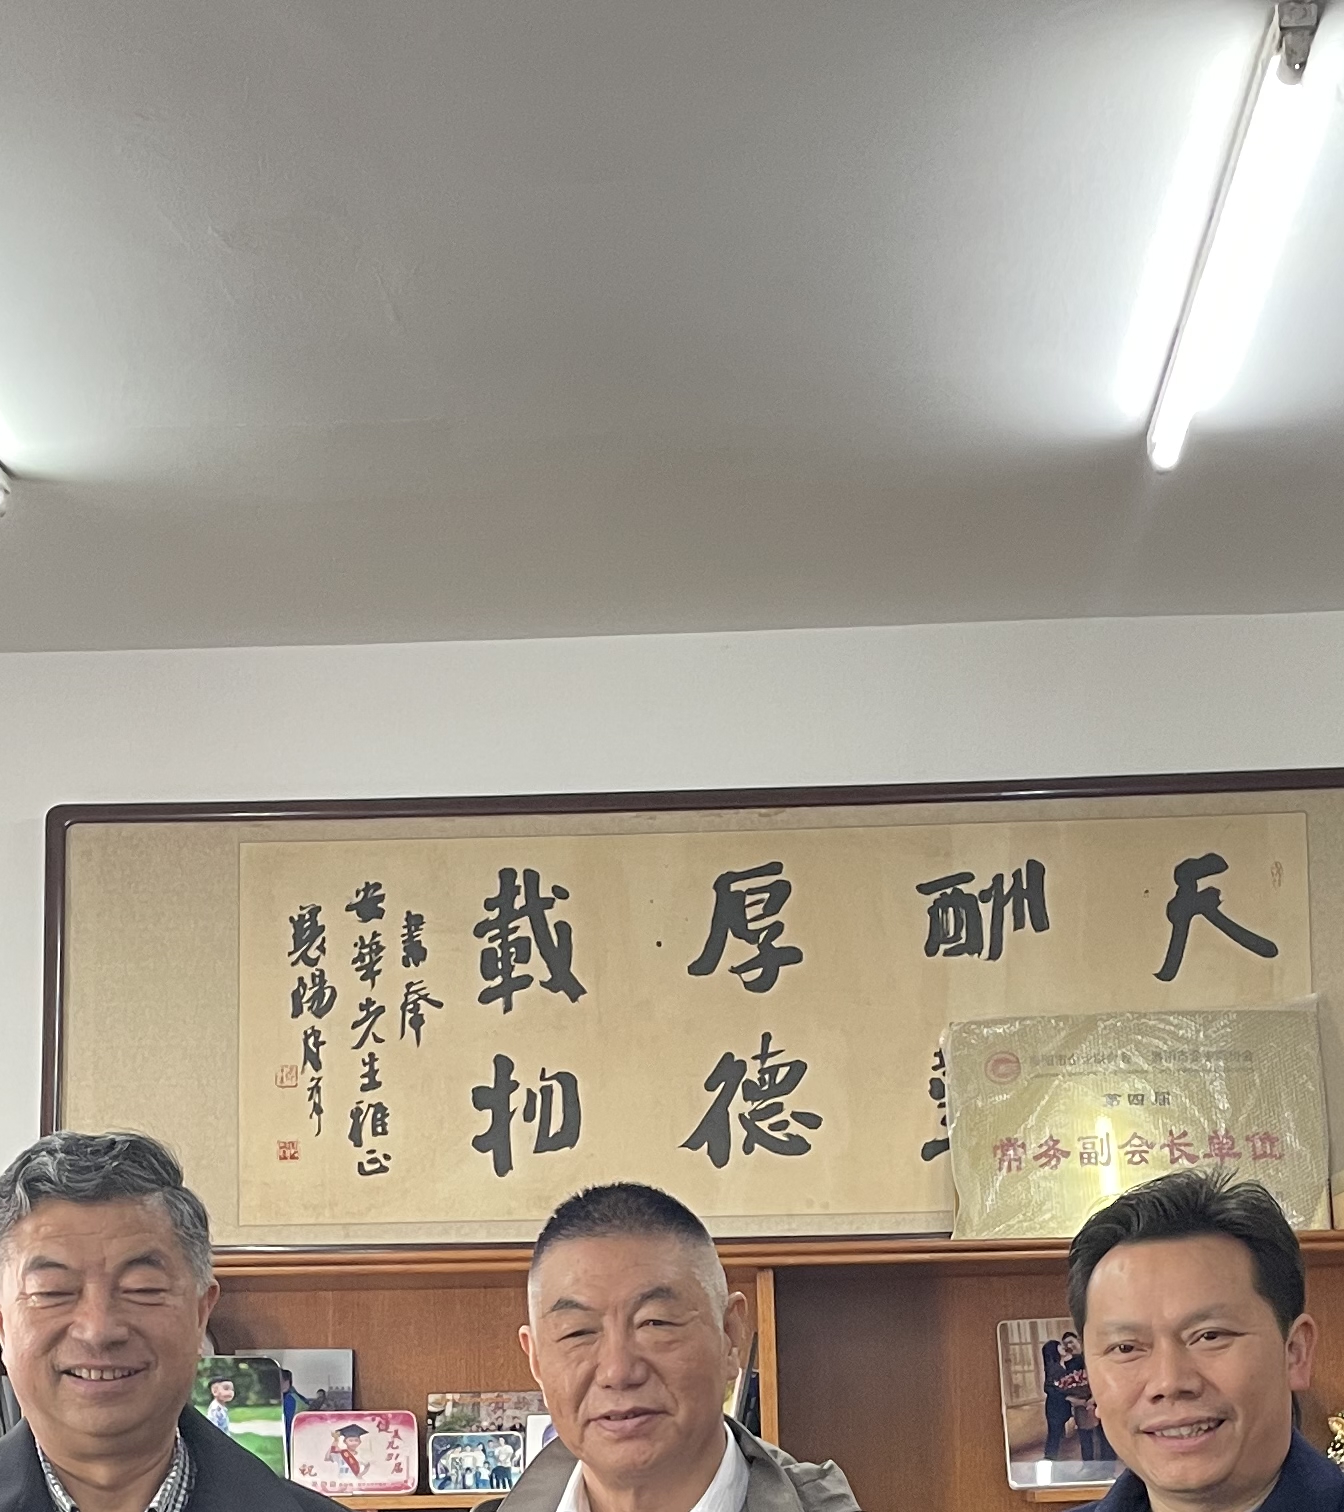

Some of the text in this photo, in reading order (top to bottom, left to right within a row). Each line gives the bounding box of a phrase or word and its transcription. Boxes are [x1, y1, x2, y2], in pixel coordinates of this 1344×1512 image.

[992, 1129, 1284, 1173] 常务副会长单位
